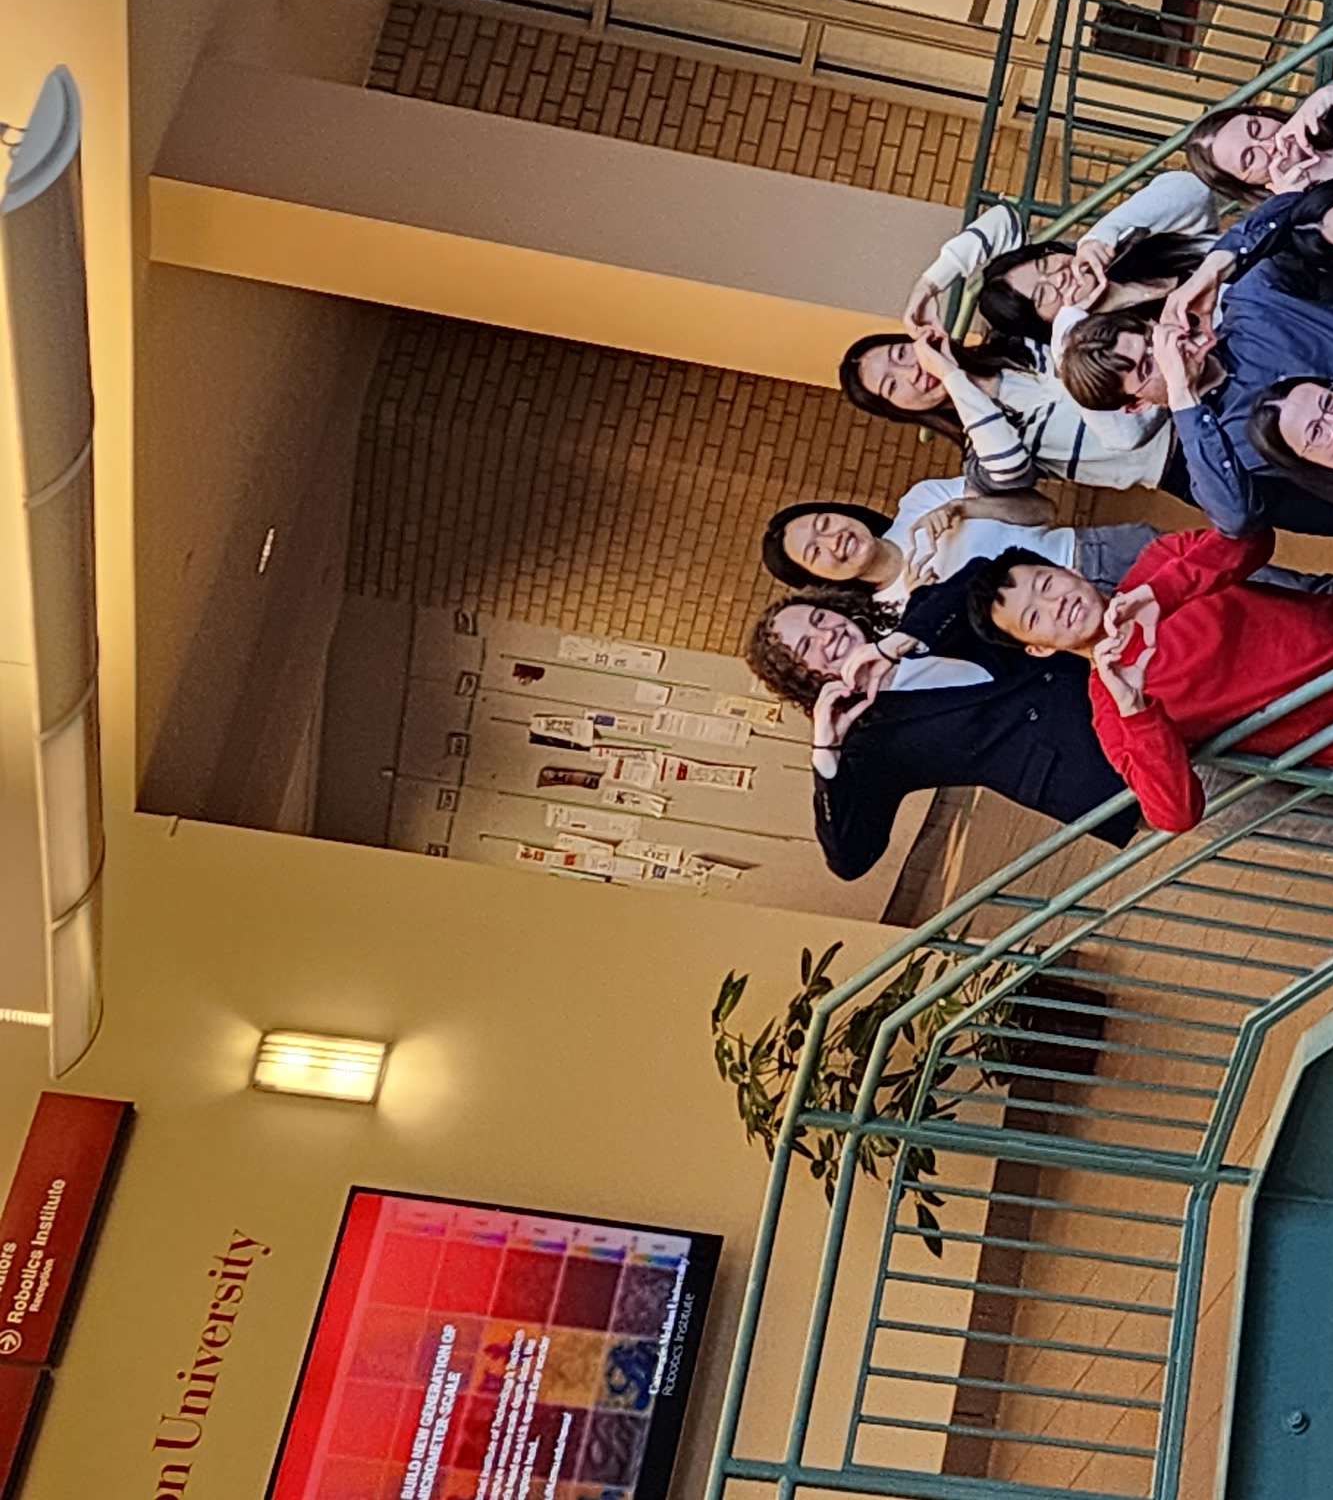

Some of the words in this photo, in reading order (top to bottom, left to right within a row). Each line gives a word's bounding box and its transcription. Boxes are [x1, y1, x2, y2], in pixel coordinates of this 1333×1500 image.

[6, 1249, 44, 1324] Robotics
[30, 1178, 66, 1246] Institute
[29, 1258, 55, 1312] Reception
[152, 1228, 272, 1452] University
[420, 1344, 453, 1426] GENERATION
[410, 1427, 430, 1458] NEW
[400, 1460, 422, 1500] BUILD
